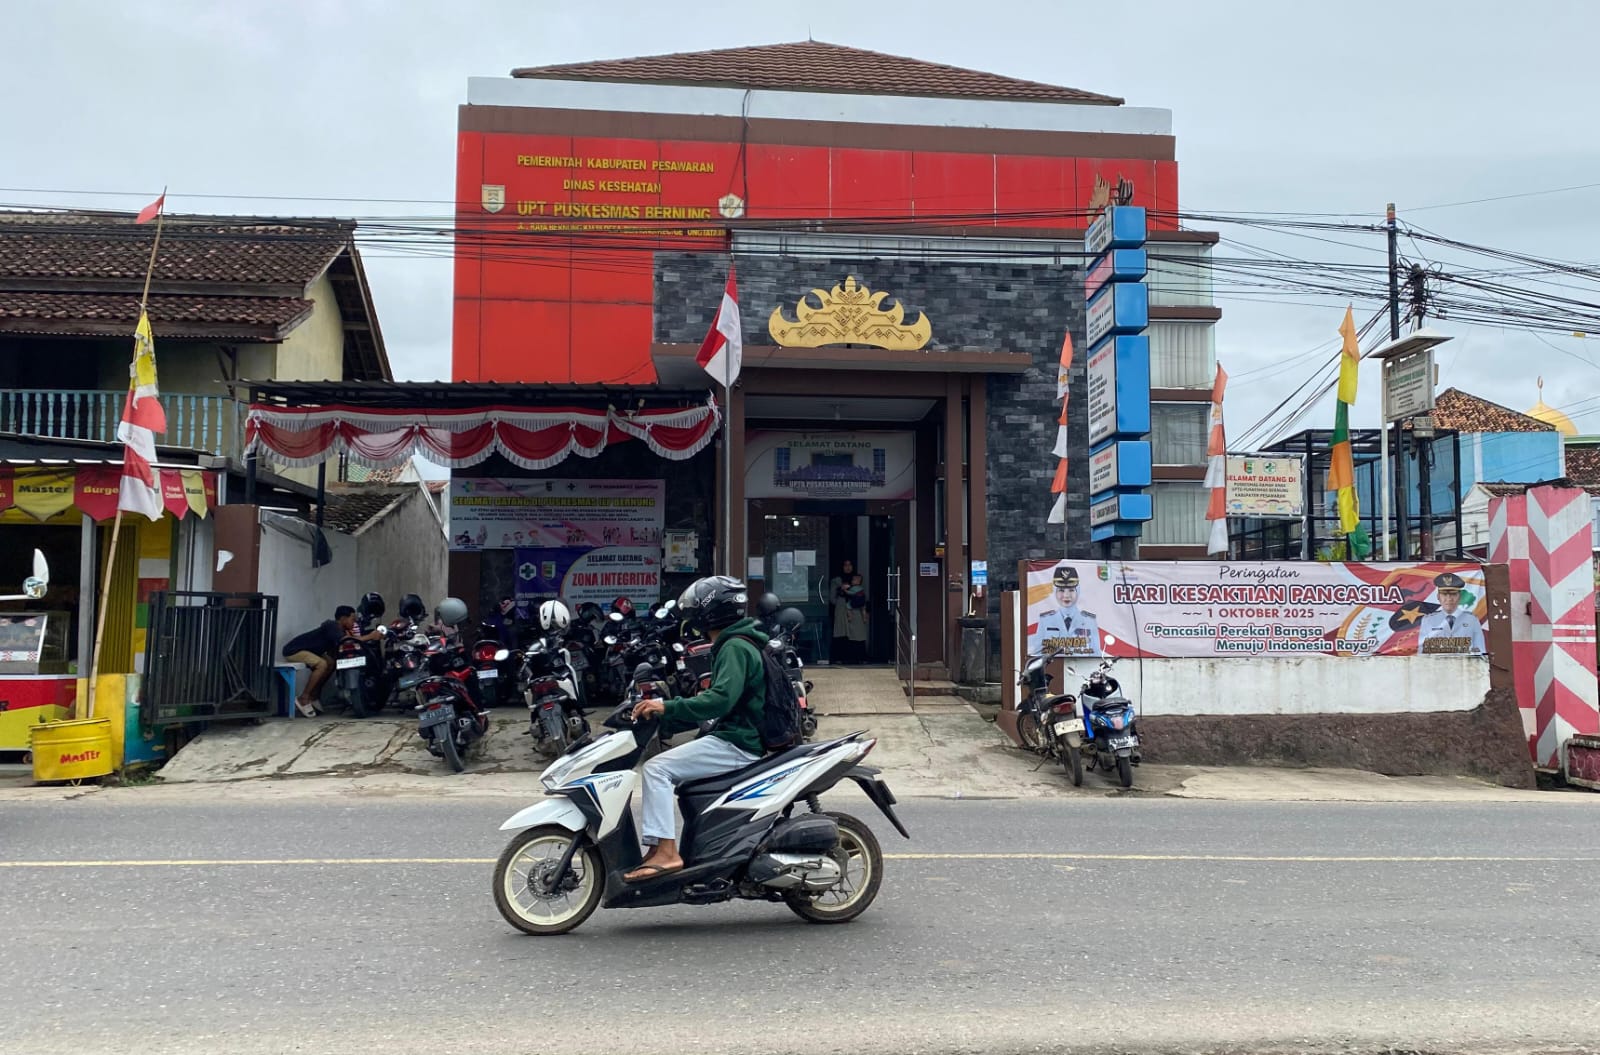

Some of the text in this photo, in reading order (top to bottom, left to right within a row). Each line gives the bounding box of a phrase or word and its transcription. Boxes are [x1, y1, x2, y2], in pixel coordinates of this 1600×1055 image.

[518, 155, 714, 173] PEMERINTAH KABUPATEN PESAWARAN
[563, 179, 661, 193] DINAS KESEHATAN
[517, 200, 546, 217] UPT
[553, 203, 640, 219] PUSKESMAS
[18, 485, 69, 493] Master
[83, 485, 119, 496] Burge
[587, 554, 643, 563] SELAMAT DATANG
[572, 572, 658, 586] ZONA INTEGRITAS
[1219, 565, 1300, 583] Peringatan
[1114, 584, 1403, 604] HARI KESAKTIAN PANCASILA
[1207, 608, 1315, 619] 1 OKTOBER 2025
[1221, 624, 1271, 638] Perekat
[1273, 625, 1323, 639] Bangsa
[1216, 639, 1265, 653] Menuju
[1268, 639, 1335, 652] Indonesia
